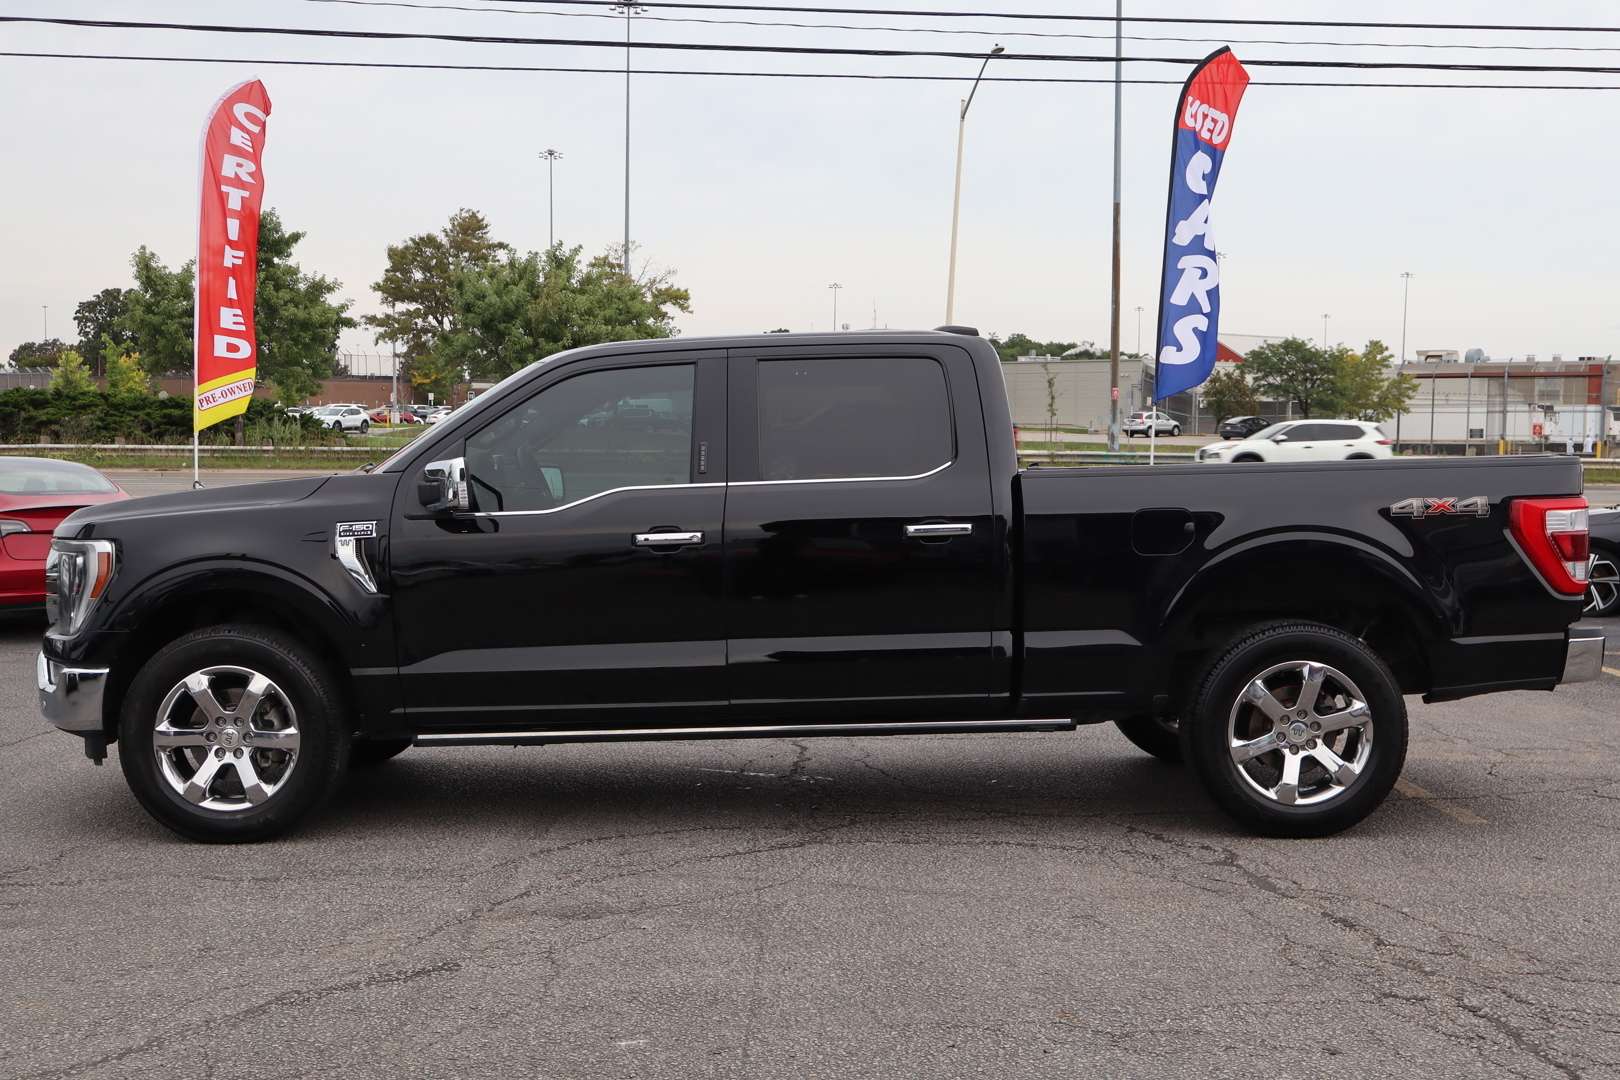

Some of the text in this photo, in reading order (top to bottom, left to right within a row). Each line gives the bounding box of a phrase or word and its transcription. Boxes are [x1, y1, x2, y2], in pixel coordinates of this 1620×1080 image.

[1184, 96, 1229, 144] USED
[213, 102, 267, 359] CERTIFIED
[1159, 150, 1219, 365] CARS
[198, 382, 253, 408] PRE-OWNED
